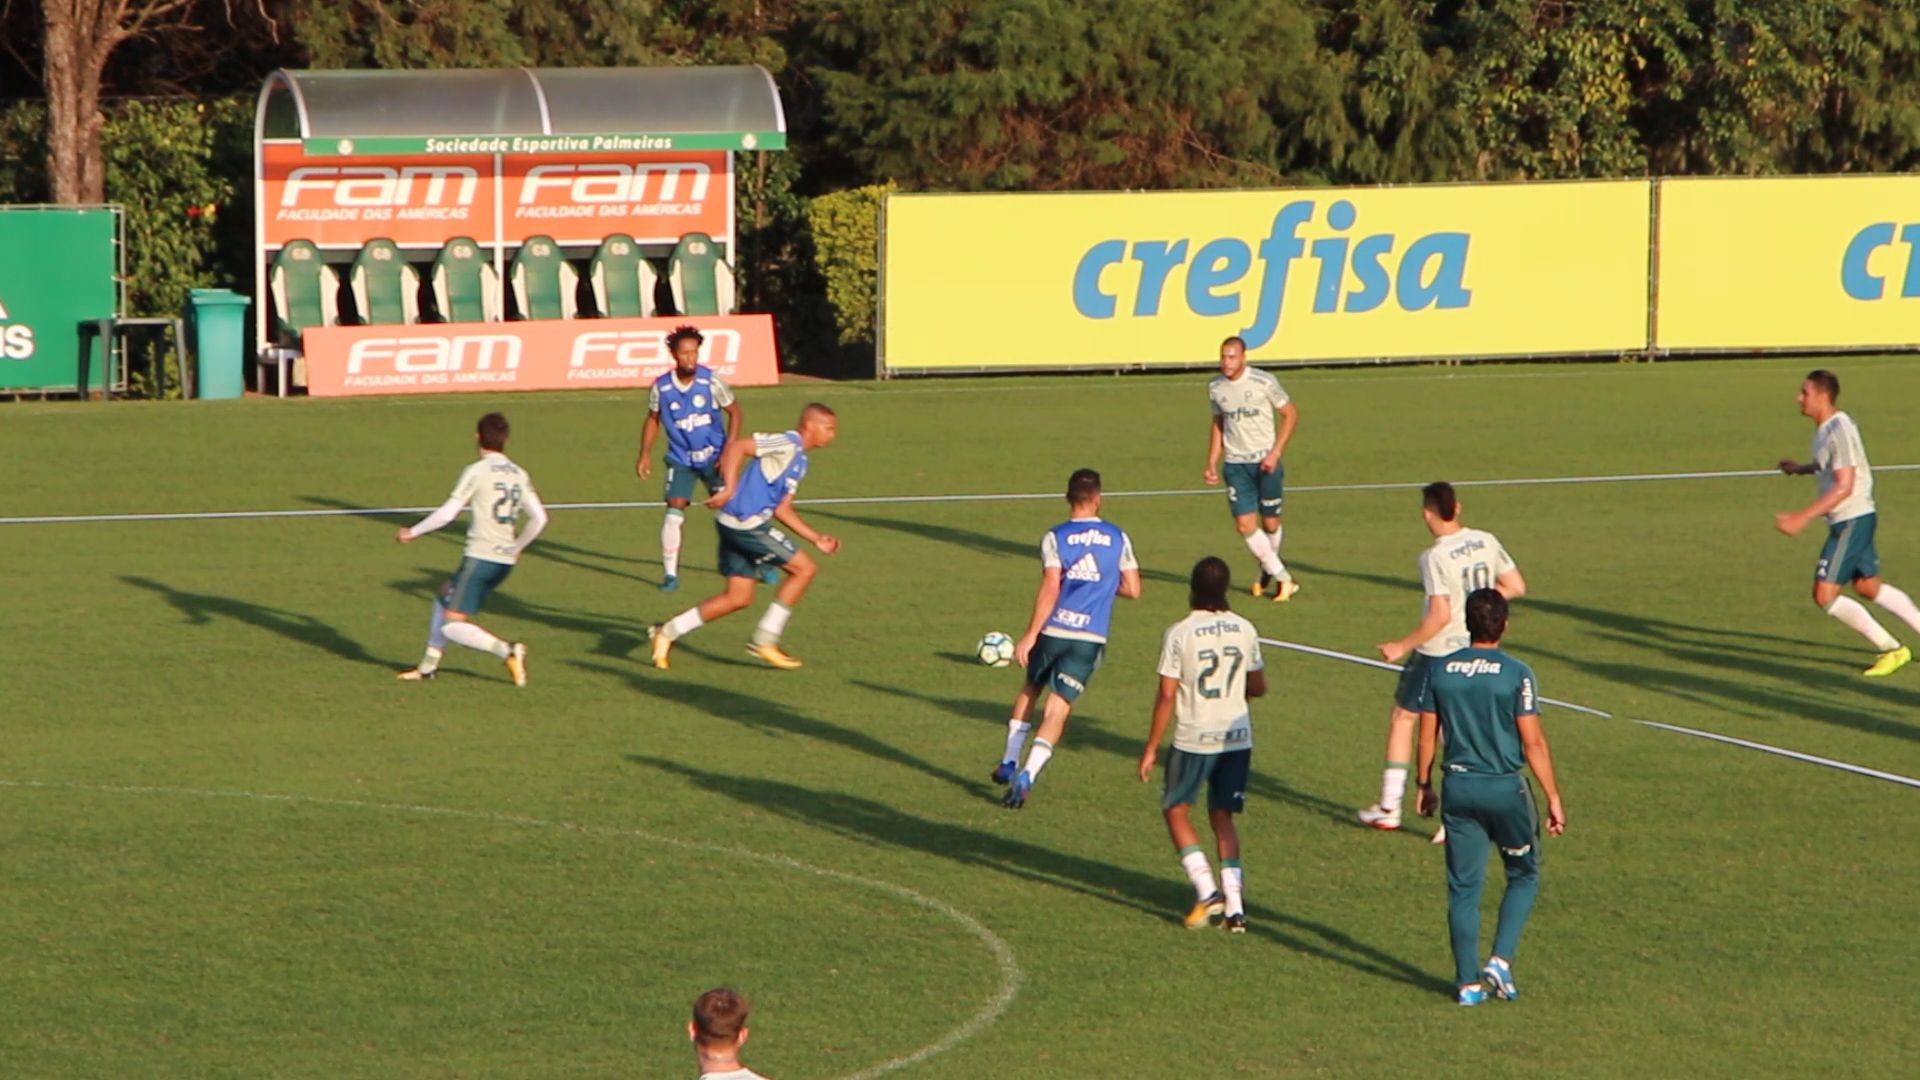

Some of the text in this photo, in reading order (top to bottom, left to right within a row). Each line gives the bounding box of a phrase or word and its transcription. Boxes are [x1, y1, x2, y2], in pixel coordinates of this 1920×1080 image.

[425, 135, 672, 154] Sociedade Esportiva Palmeiras
[276, 208, 358, 221] FACULDADE
[362, 208, 392, 220] DAS
[515, 204, 594, 218] FACULDADE
[598, 204, 626, 216] DAS
[1072, 200, 1471, 349] crefisa
[421, 372, 448, 384] DAS
[1066, 528, 1112, 547] crefisa
[1194, 620, 1241, 638] crefisa
[1197, 645, 1244, 700] 27
[1446, 658, 1502, 678] crefisa
